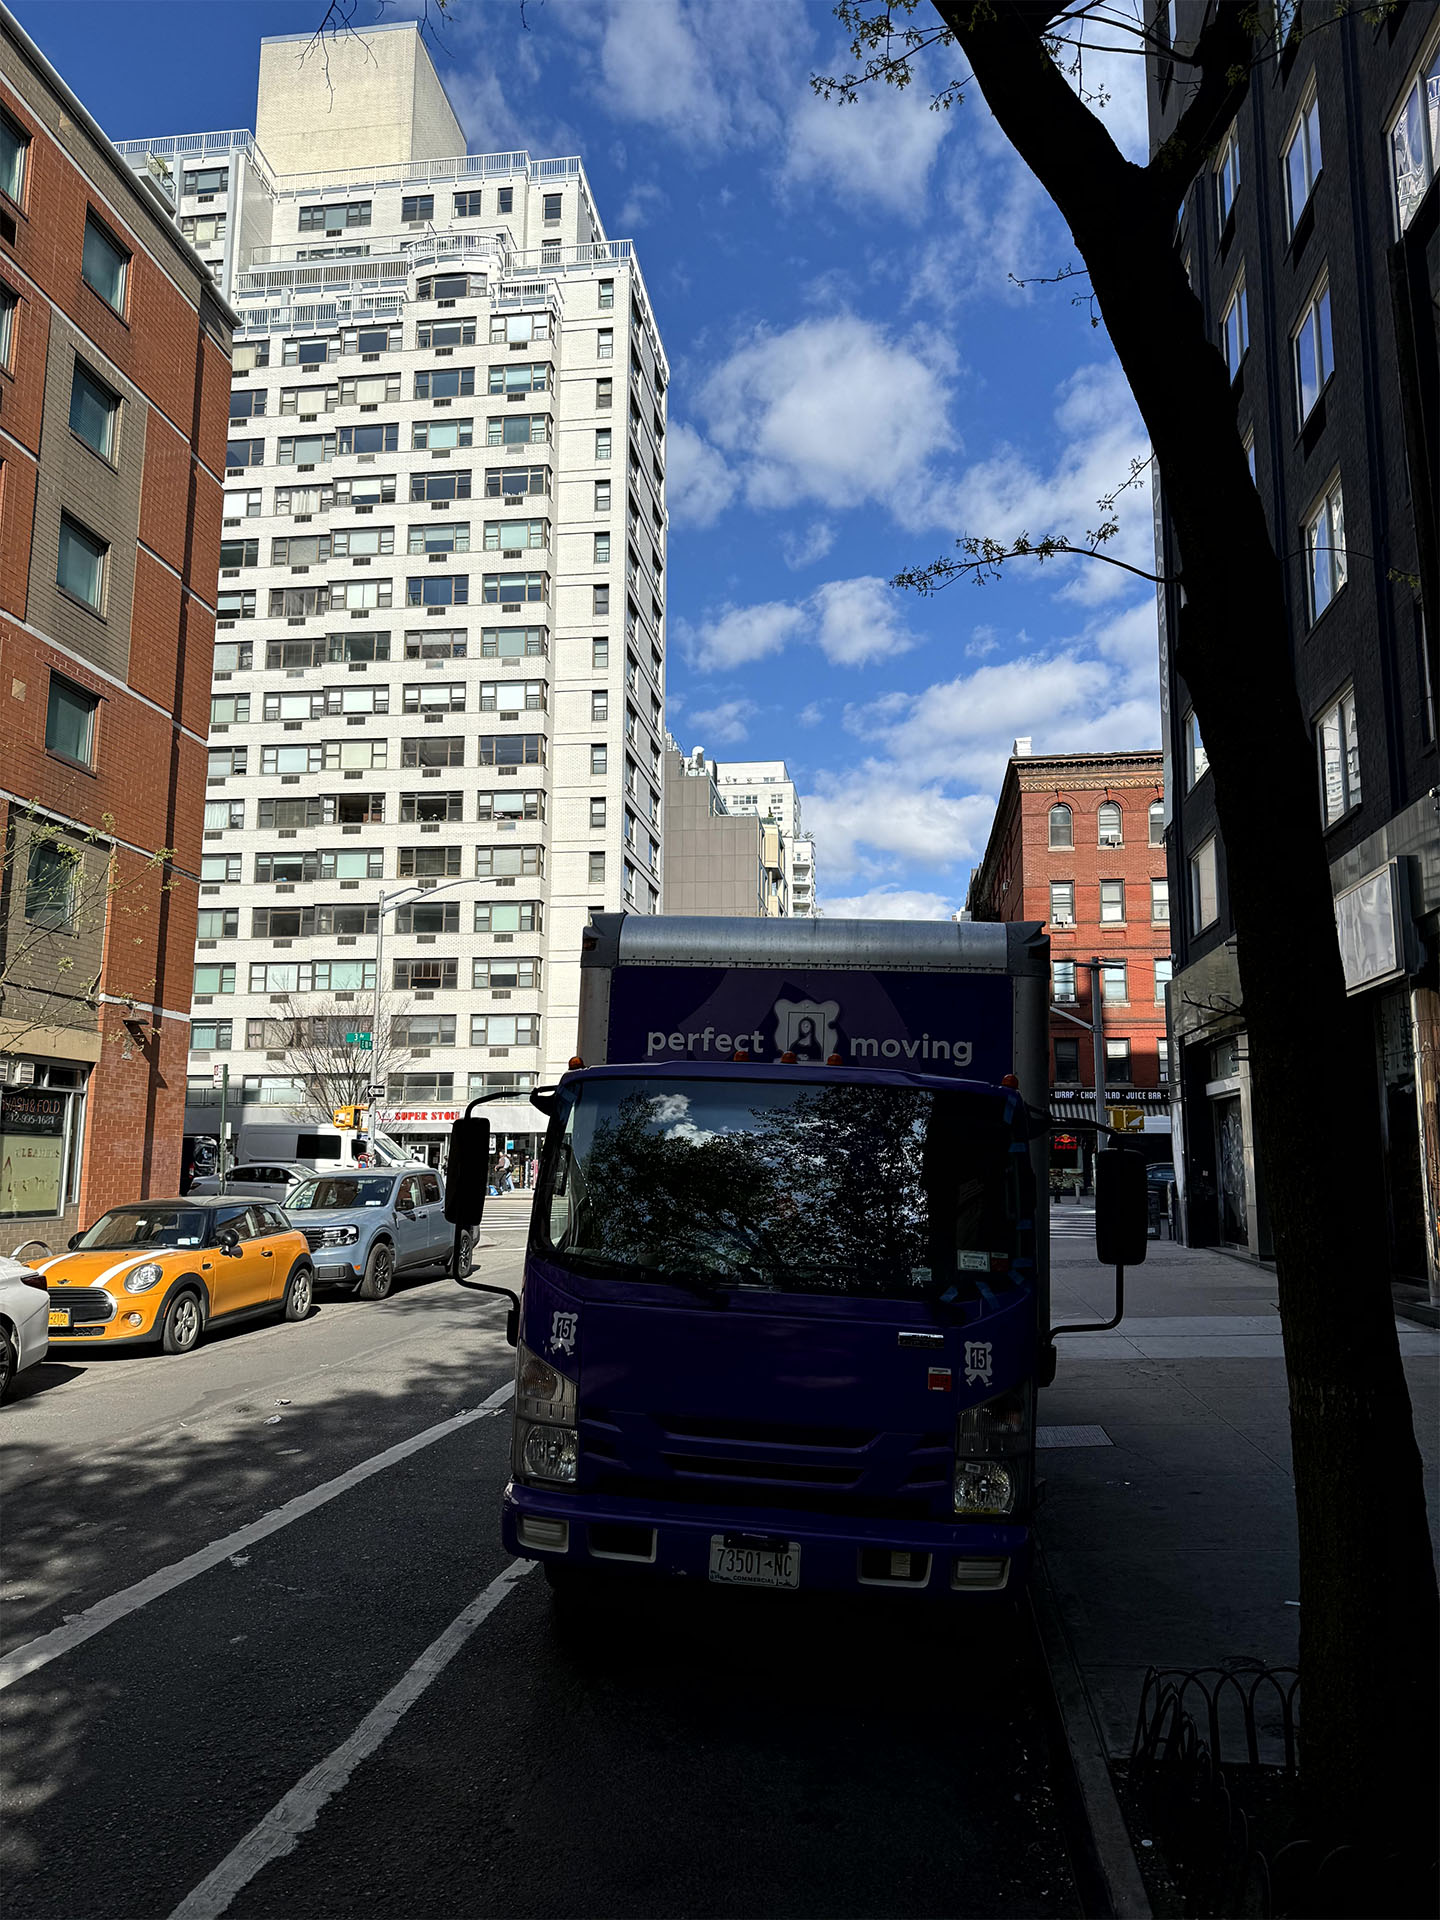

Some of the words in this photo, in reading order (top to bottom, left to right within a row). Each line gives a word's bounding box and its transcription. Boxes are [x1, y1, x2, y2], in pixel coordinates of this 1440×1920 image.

[648, 1027, 764, 1056] perfect
[850, 1033, 973, 1067] moving
[1055, 1091, 1075, 1099] WRAP
[1104, 1091, 1121, 1099] ALAD
[1126, 1091, 1146, 1100] JUICE
[1148, 1091, 1162, 1100] BAR
[395, 1111, 428, 1120] SUPER
[558, 1320, 570, 1338] 15
[971, 1349, 986, 1369] 15
[717, 1548, 761, 1575] 73501
[774, 1552, 792, 1577] NC
